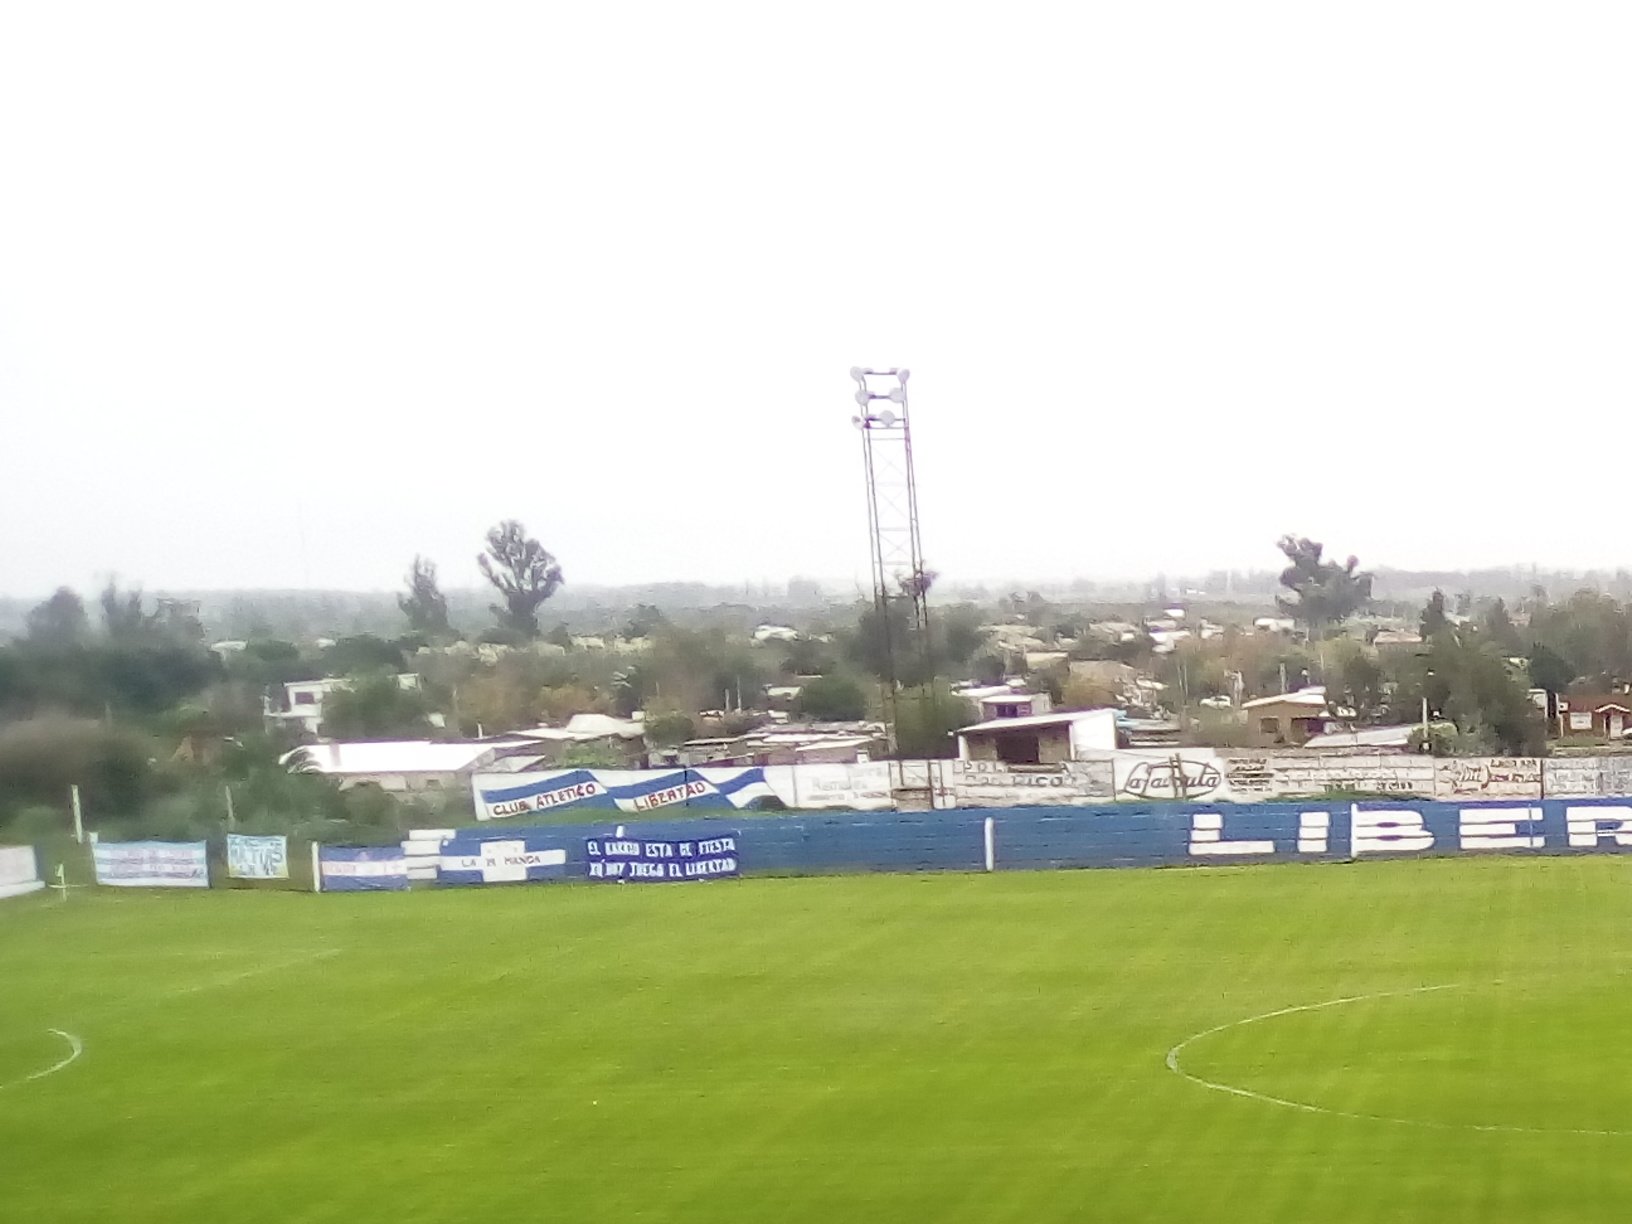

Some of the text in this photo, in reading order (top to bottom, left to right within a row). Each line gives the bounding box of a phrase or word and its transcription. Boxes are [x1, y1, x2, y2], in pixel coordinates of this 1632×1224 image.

[493, 782, 706, 815] CLUB ATLETICO LIBERTAD
[645, 842, 673, 858] ESTA
[698, 838, 736, 855] FIESTA
